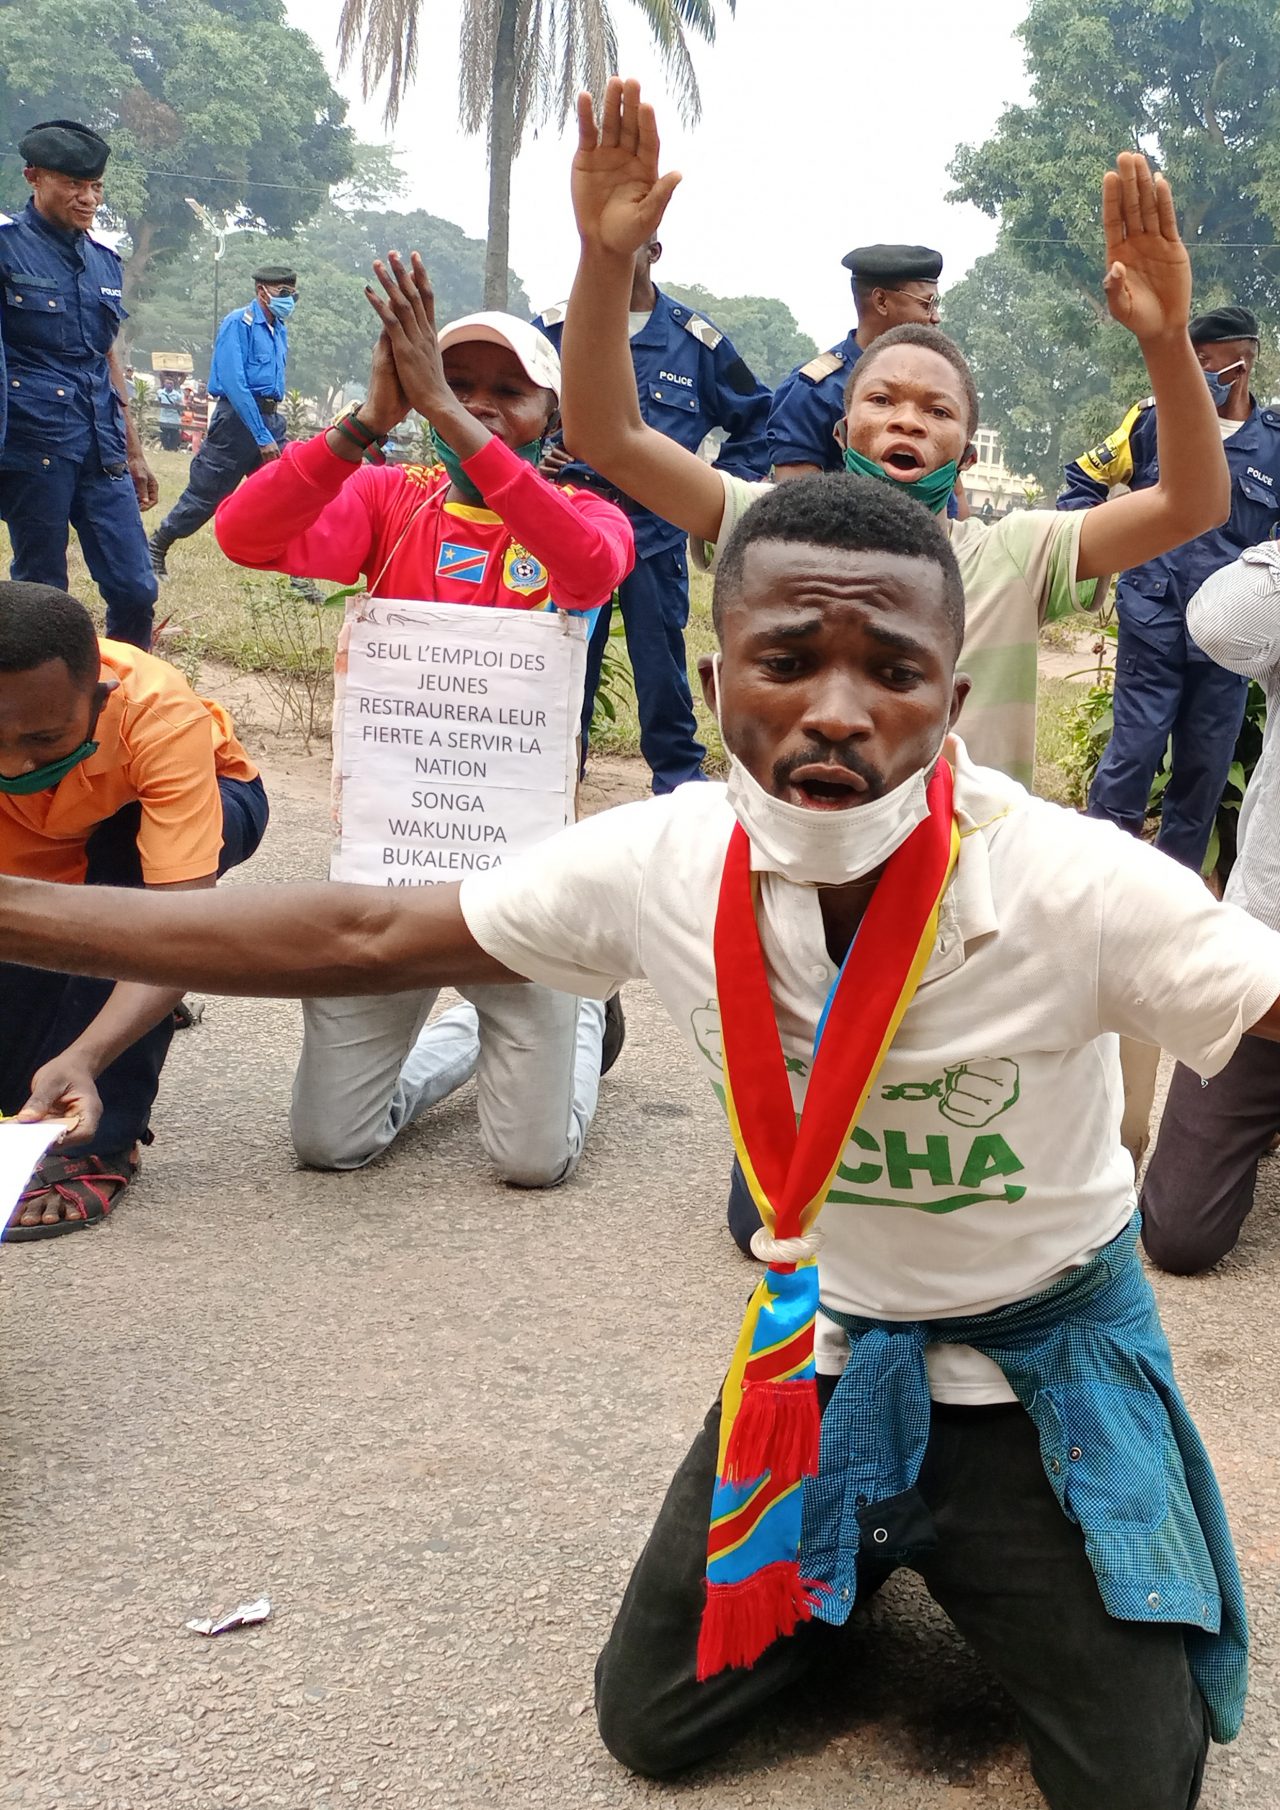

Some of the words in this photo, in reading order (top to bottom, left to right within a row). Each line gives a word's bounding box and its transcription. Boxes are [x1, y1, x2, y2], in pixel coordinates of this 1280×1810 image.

[659, 371, 694, 387] POLICE
[1246, 466, 1274, 486] POLICE
[366, 642, 411, 662] SEUL
[417, 645, 503, 668] L'EMPLOI
[510, 654, 546, 672] DES
[417, 674, 488, 694] JEUNES
[360, 697, 493, 724] RESTRAURERA
[499, 709, 547, 727] LEUR
[362, 725, 423, 746] FIERTE
[429, 732, 442, 747] A
[448, 732, 513, 753] SERVIR
[519, 738, 542, 755] LA
[415, 757, 487, 778] NATION
[411, 791, 485, 813] SONGA
[388, 819, 507, 843] WAKUNUPA
[383, 847, 502, 871] BUKALENGA
[836, 1126, 1025, 1189] CHA
